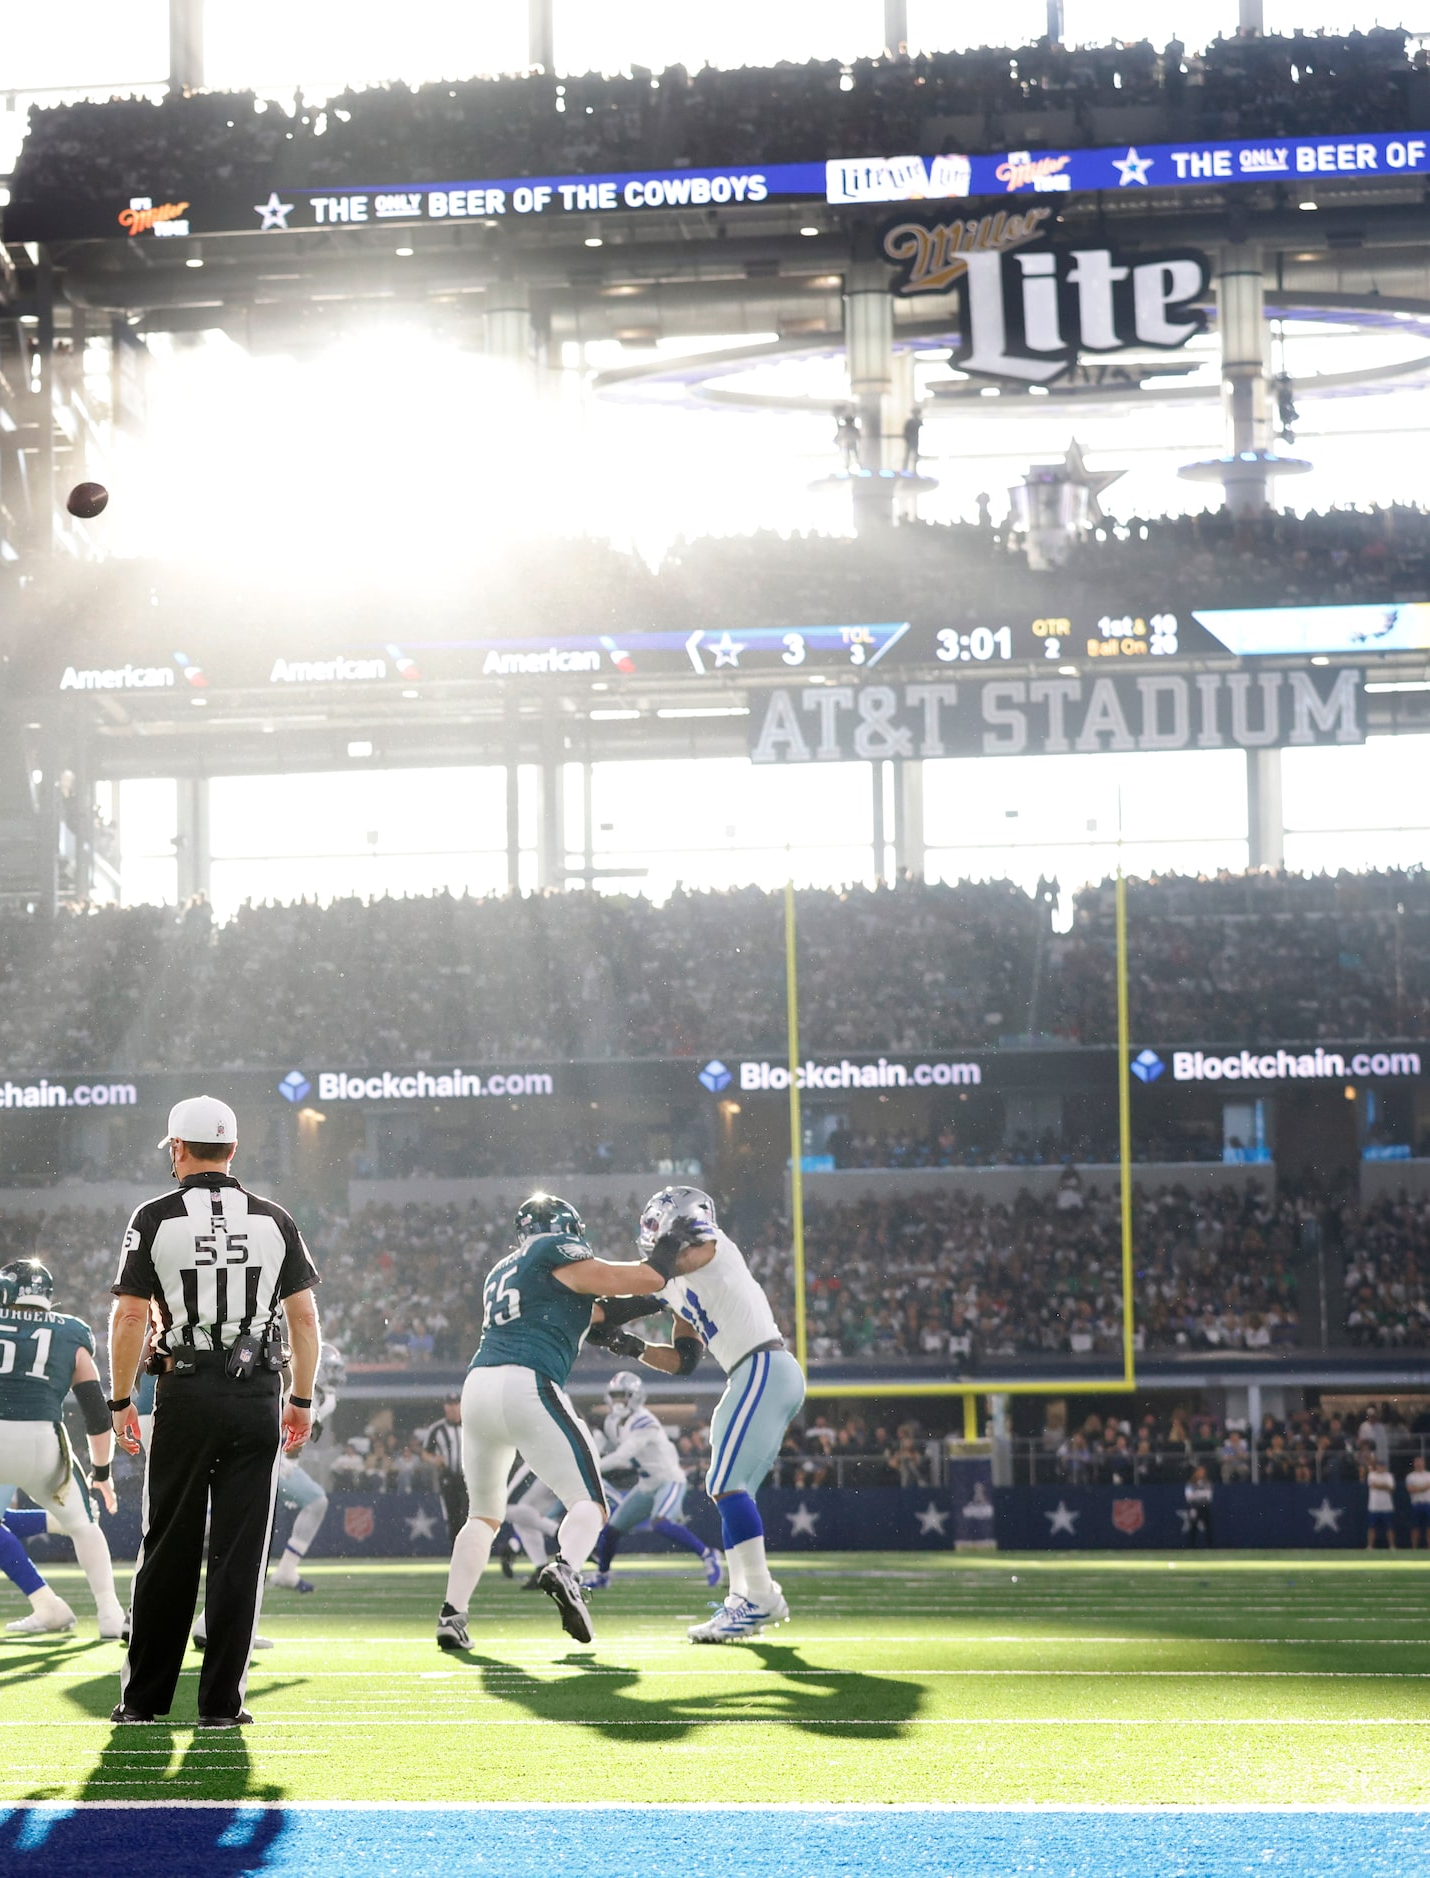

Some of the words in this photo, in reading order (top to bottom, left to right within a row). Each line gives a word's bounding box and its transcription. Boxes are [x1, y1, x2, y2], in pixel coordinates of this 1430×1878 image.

[1171, 151, 1232, 178] THE
[1239, 147, 1288, 169] ONLY
[1296, 145, 1380, 172] BEER
[1385, 141, 1427, 167] OF
[310, 196, 368, 222] THE
[375, 193, 421, 213] ONLY
[428, 191, 509, 218] BEER
[514, 186, 551, 213] OF
[558, 183, 617, 211] THE
[624, 174, 767, 208] COWBOYS
[883, 207, 1052, 293] Miller
[952, 249, 1203, 381] Lite
[839, 625, 876, 645] TOL
[1032, 617, 1071, 637] QTR
[1098, 616, 1133, 638] 1st
[781, 632, 806, 666] 3
[849, 643, 866, 666] 3
[936, 626, 1012, 662] 3:01
[1044, 637, 1060, 659] 2
[1086, 638, 1119, 658] Ball
[1120, 637, 1148, 656] On
[269, 655, 386, 684] American
[483, 646, 601, 676] American
[60, 663, 174, 692] American
[752, 682, 958, 763] AT&T
[981, 667, 1364, 756] STADIUM
[1172, 1047, 1421, 1081] Blockchain.com
[318, 1069, 553, 1101] Blockchain.com
[210, 1216, 228, 1234] R
[194, 1234, 249, 1266] 55
